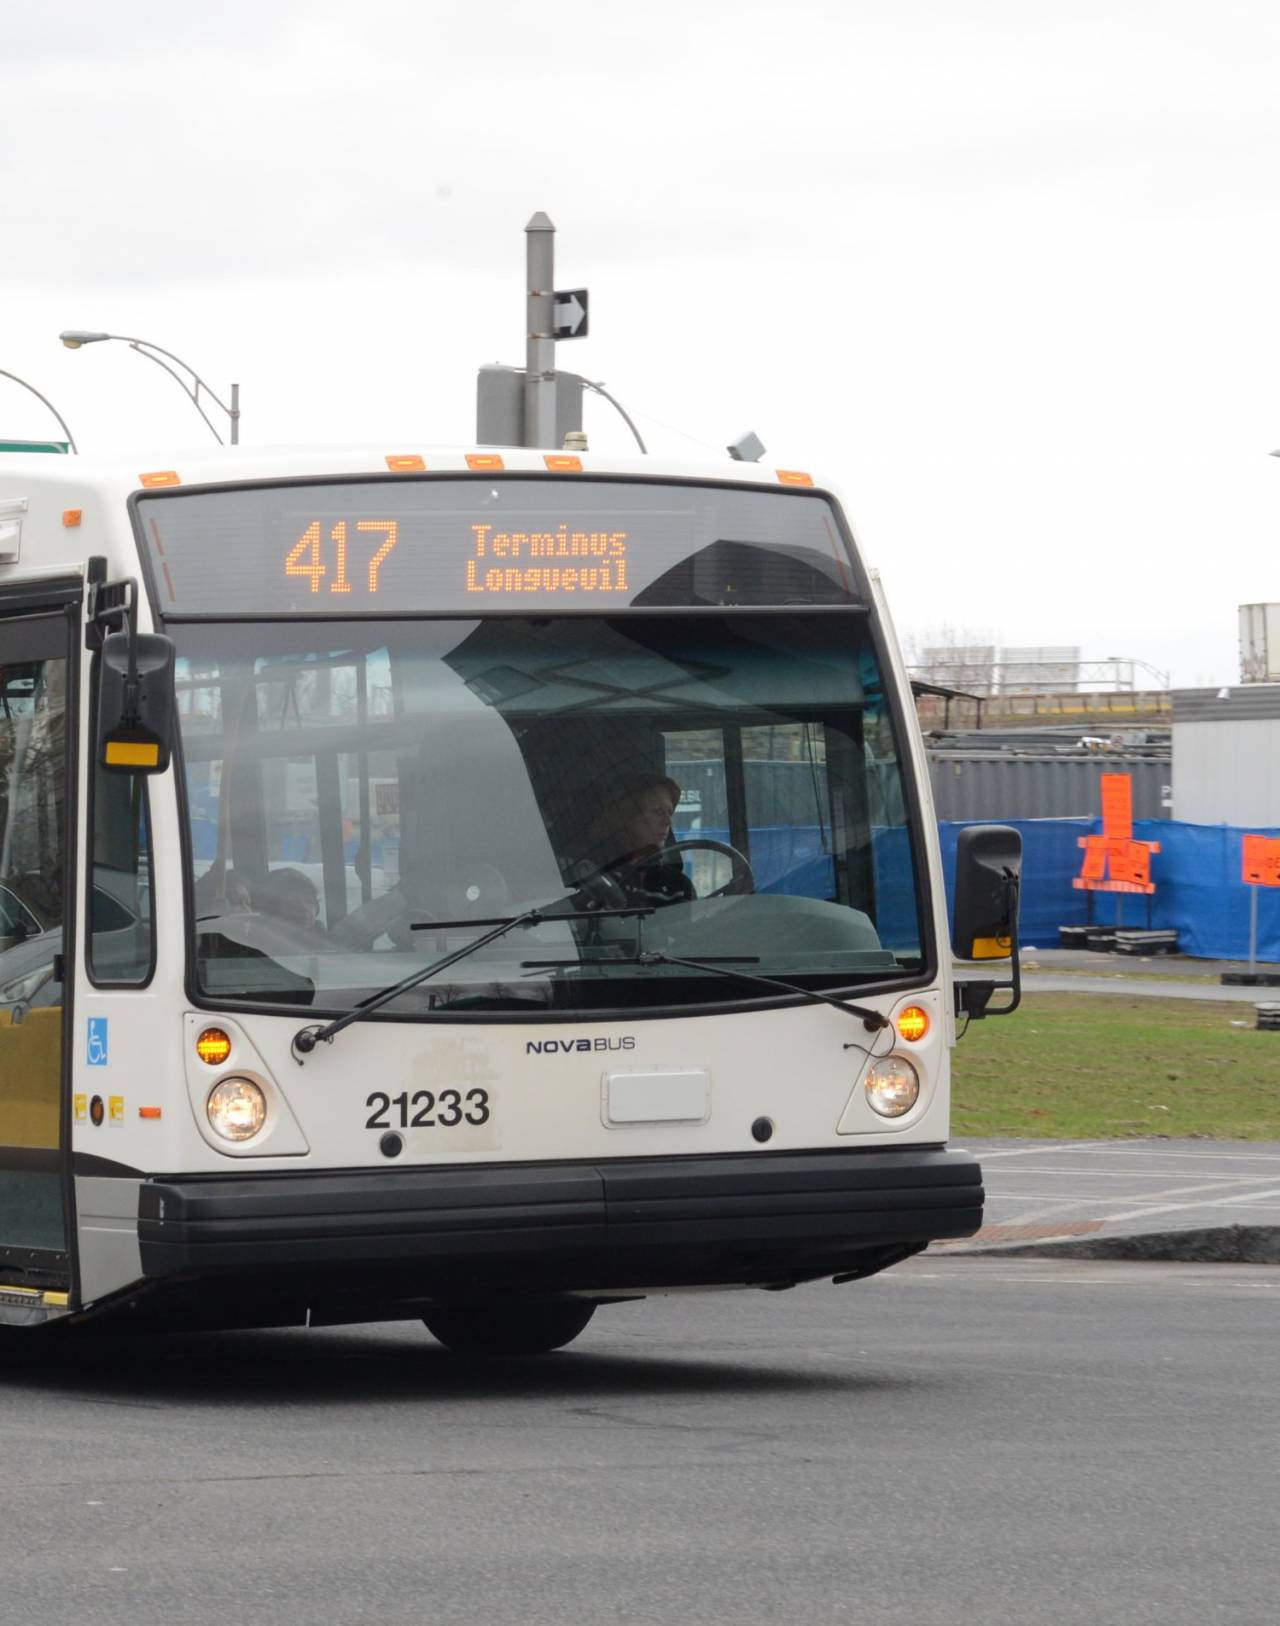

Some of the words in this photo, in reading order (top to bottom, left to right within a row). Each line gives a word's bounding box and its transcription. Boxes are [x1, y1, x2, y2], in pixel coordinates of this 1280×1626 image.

[285, 521, 397, 592] 417
[472, 524, 627, 557] Terminus
[467, 559, 628, 592] Longueuil
[365, 1088, 490, 1129] 21233
